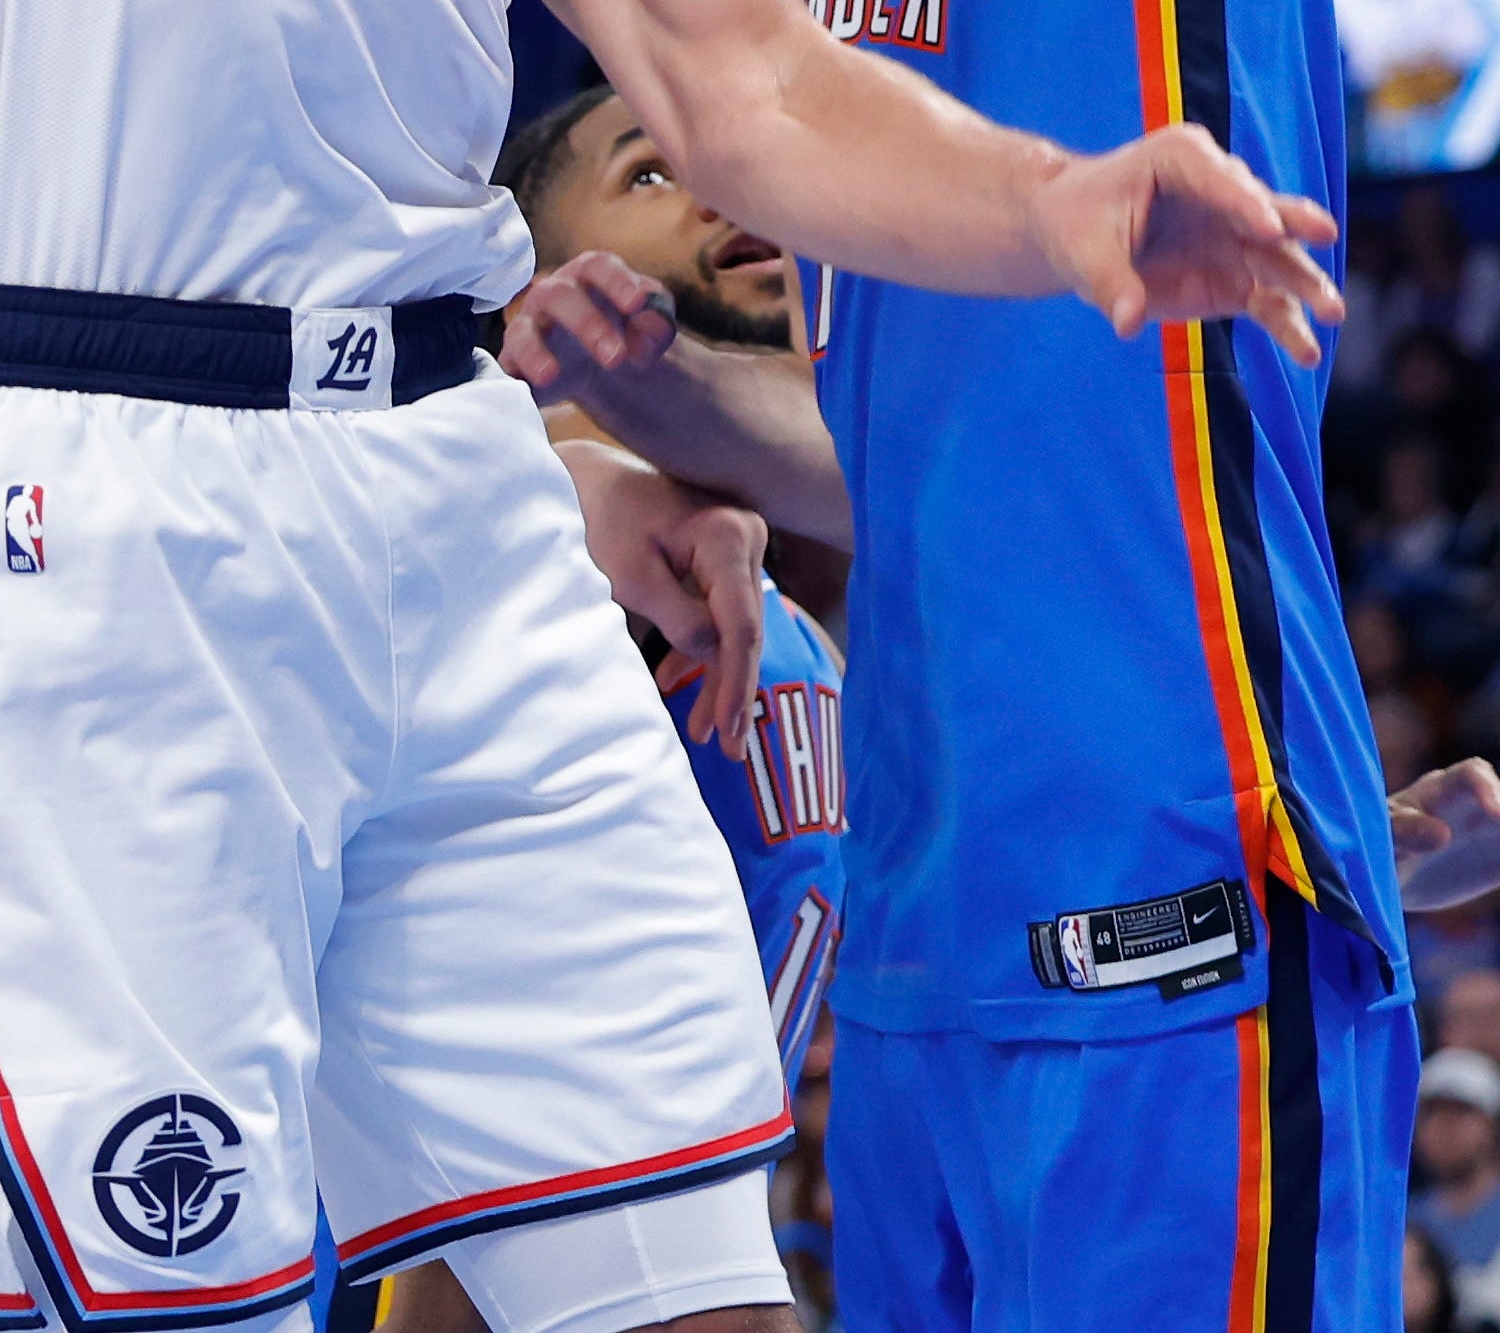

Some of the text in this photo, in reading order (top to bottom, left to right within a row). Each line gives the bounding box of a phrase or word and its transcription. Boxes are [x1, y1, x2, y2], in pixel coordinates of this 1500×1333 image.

[316, 321, 378, 391] LA
[10, 554, 33, 571] NBA
[744, 681, 850, 846] THU
[1096, 930, 1112, 946] 48
